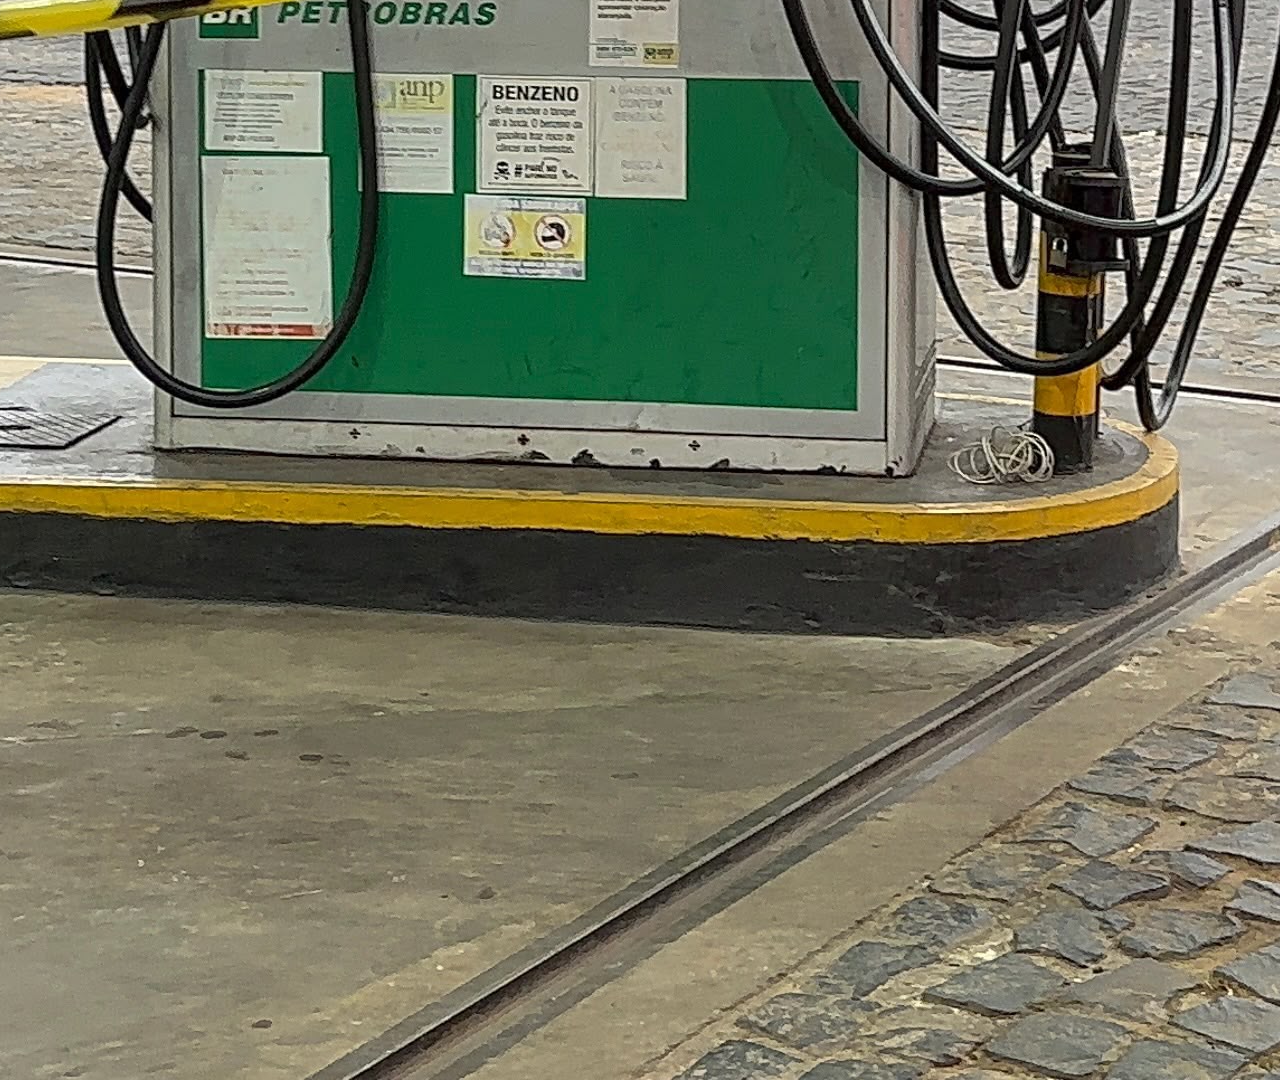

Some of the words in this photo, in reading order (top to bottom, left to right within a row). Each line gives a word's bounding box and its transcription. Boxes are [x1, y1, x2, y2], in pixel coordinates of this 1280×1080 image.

[277, 0, 498, 26] PETOBRAS
[400, 79, 446, 104] anp
[491, 84, 580, 102] BENZENO
